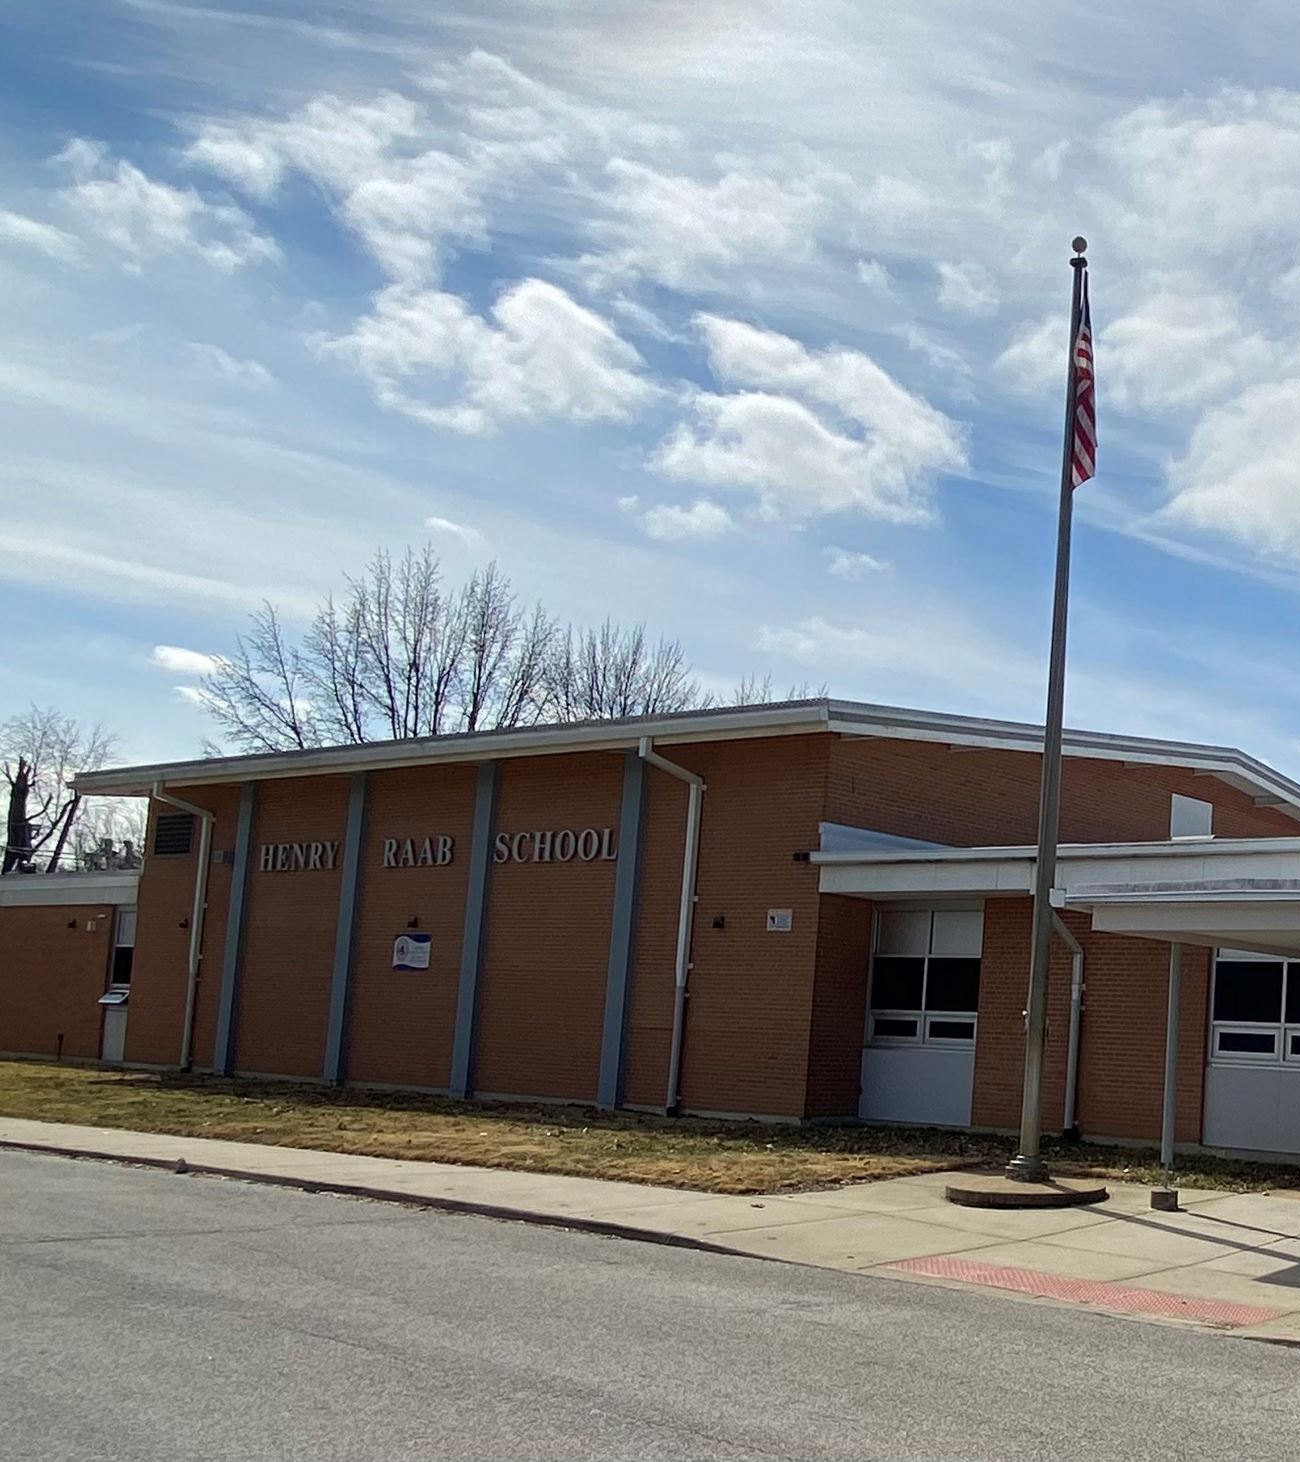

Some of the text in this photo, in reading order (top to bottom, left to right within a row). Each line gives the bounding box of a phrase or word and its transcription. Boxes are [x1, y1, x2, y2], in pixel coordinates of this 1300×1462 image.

[259, 828, 617, 871] HENRY RAAB SCHOOL
